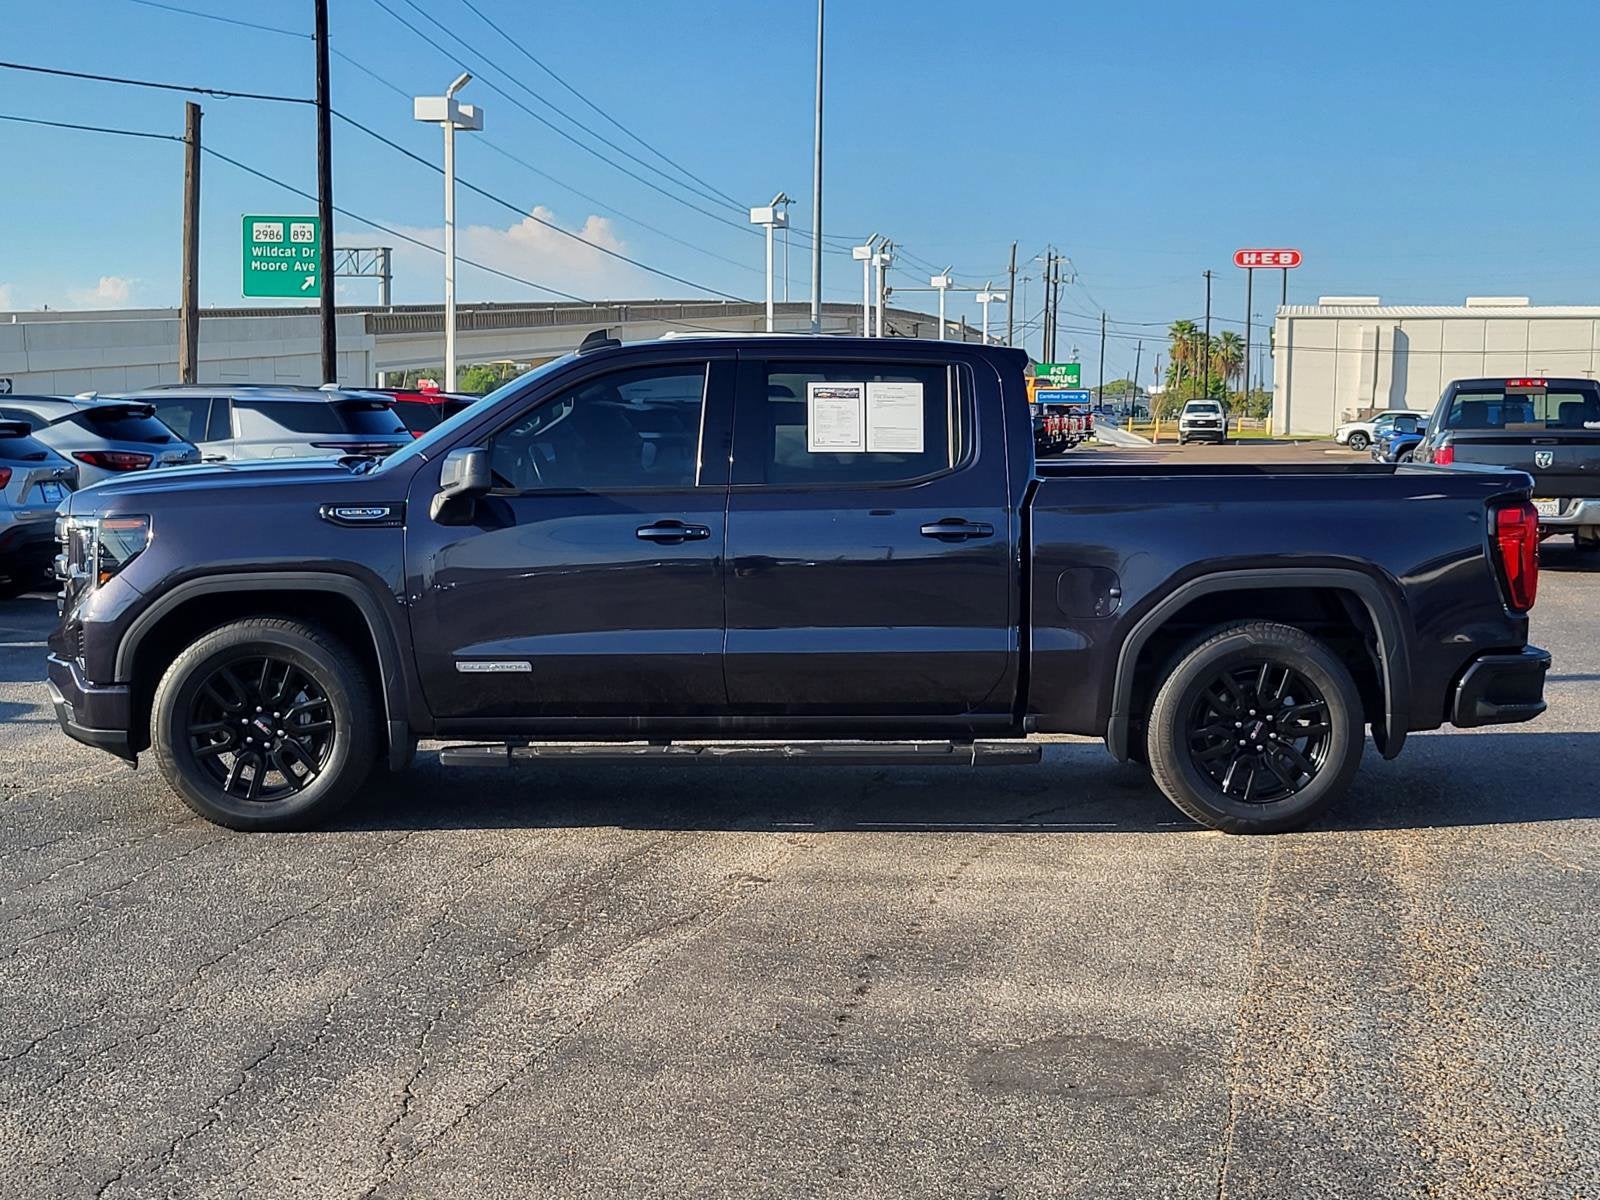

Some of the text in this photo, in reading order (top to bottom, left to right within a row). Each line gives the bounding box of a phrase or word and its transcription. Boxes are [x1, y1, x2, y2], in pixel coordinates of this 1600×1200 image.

[255, 229, 282, 240] 2986
[292, 230, 313, 240] 893
[251, 246, 316, 257] Wildcat Dr
[251, 260, 316, 271] Moore Ave
